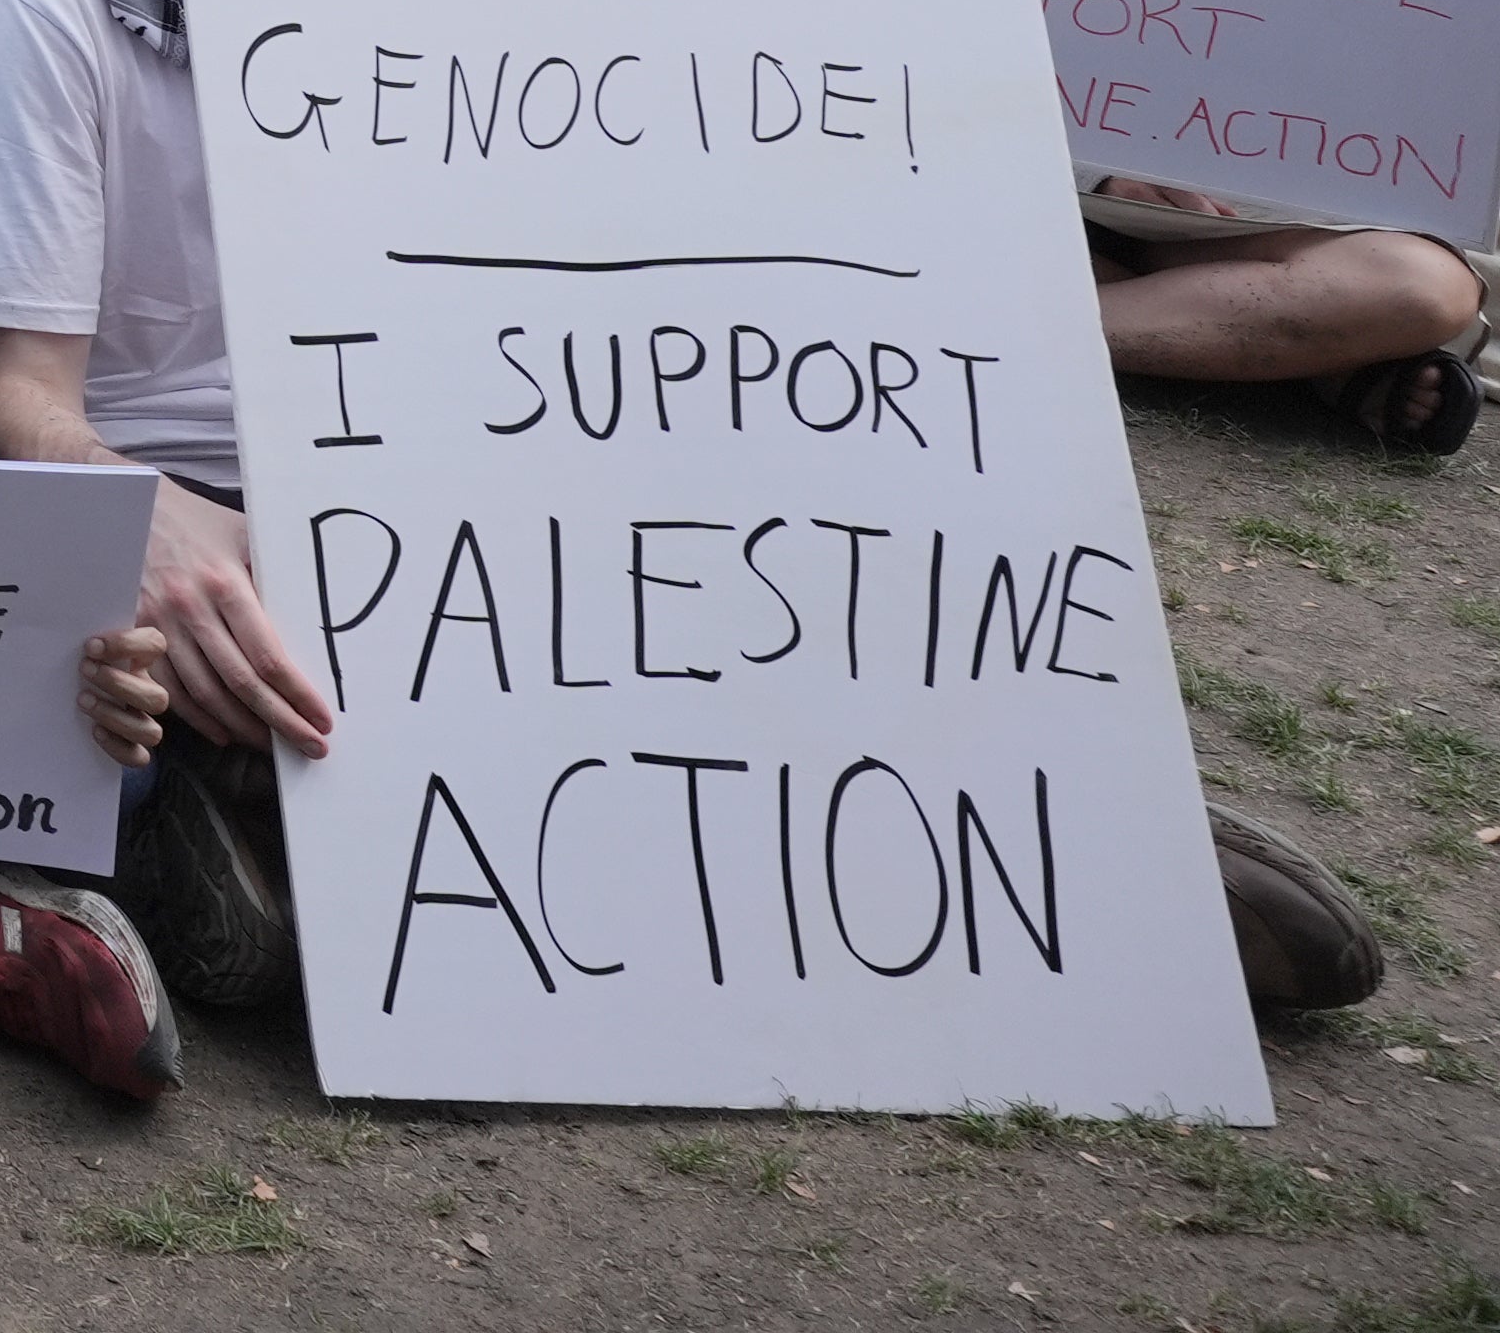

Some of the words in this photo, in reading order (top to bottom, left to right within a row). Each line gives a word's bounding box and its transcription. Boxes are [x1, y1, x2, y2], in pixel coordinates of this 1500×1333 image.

[240, 21, 922, 177] GENOCIDE!
[1175, 97, 1466, 201] ACTION
[290, 328, 385, 451] I
[482, 322, 1001, 477] SUPPORT
[307, 505, 1138, 715] PALESTINE
[381, 750, 1067, 1017] ACTION
